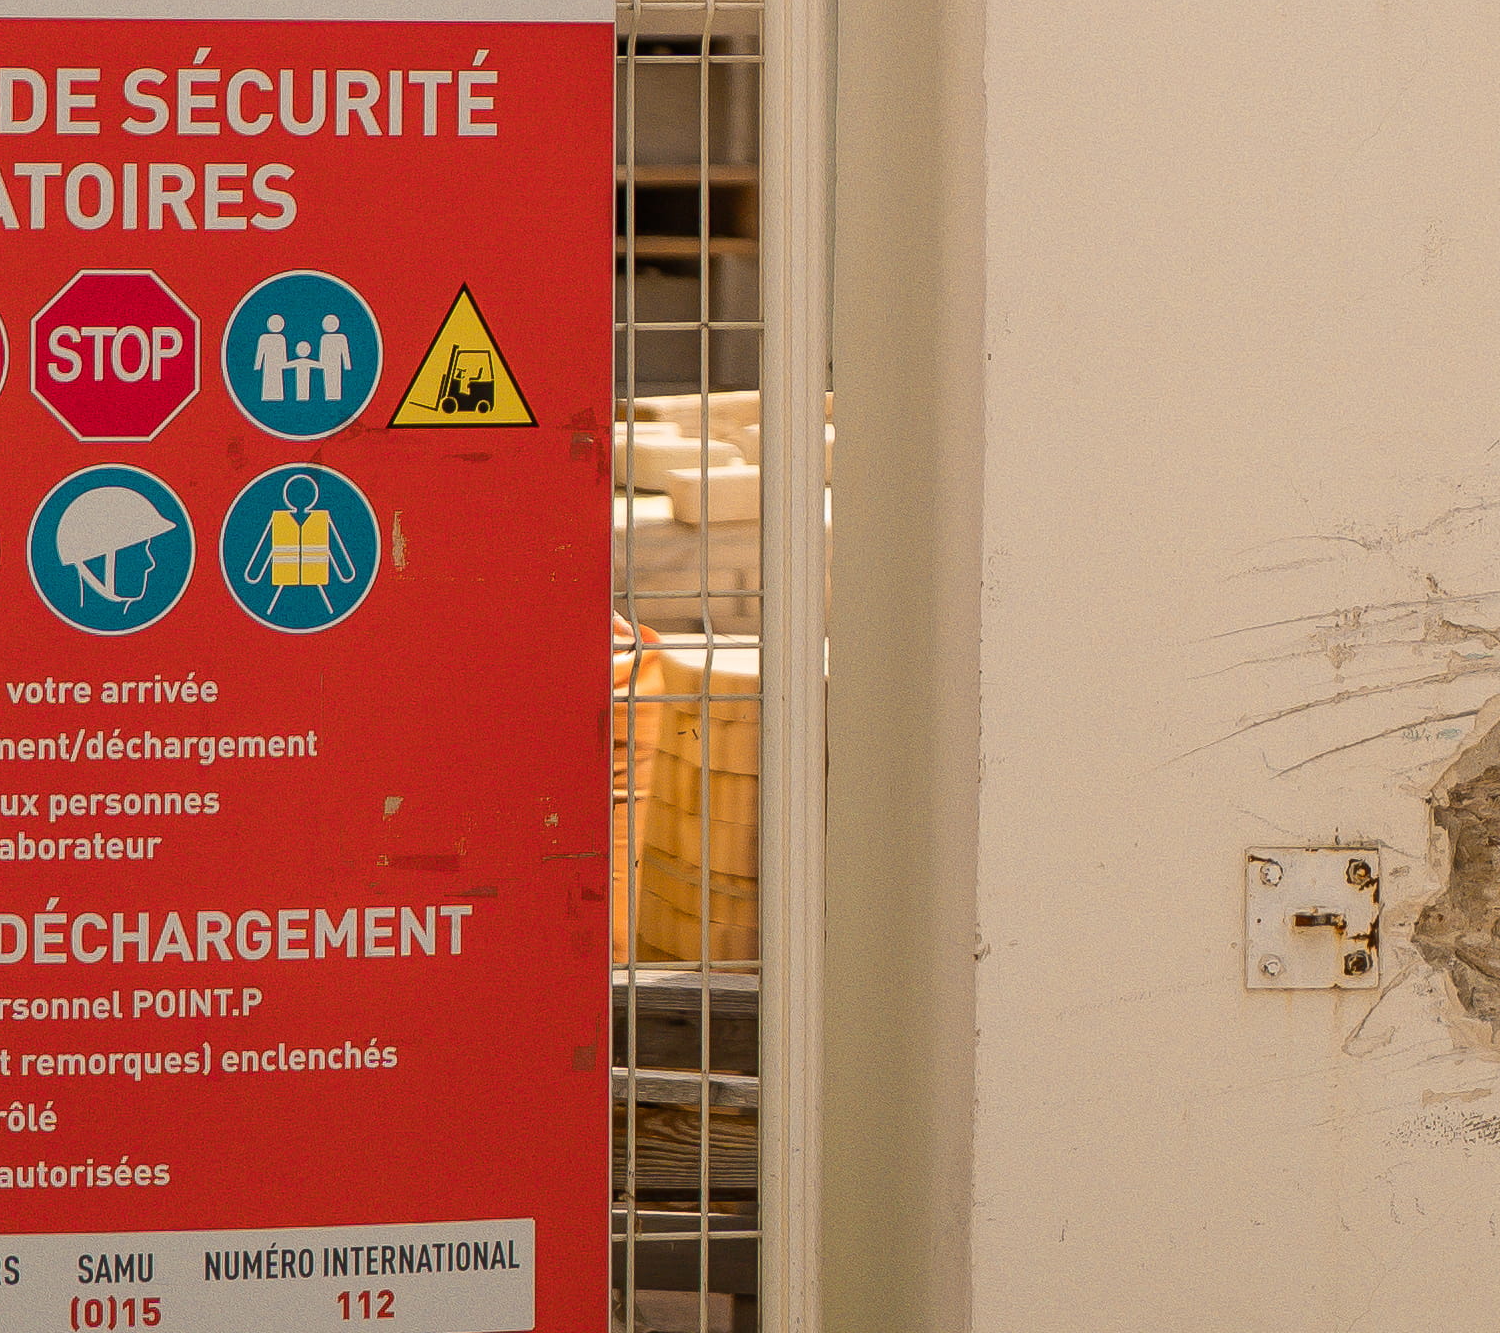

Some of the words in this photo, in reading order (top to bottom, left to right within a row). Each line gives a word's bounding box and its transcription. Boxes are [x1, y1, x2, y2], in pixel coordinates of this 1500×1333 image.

[0, 68, 100, 134] DE
[122, 48, 497, 136] SÉCURITÉ
[46, 322, 184, 384] STOP
[7, 677, 91, 703] votre
[101, 672, 218, 703] arrivée
[50, 793, 219, 822] personnes
[134, 988, 262, 1018] POINT.P
[22, 1042, 211, 1081] remorques)
[222, 1038, 397, 1072] enclenchés
[79, 1254, 153, 1284] SAMU
[205, 1243, 313, 1280] NUMÉRO
[324, 1240, 519, 1276] INTERNATIONAL
[70, 1297, 160, 1330] (0)15
[337, 1290, 394, 1320] 112
